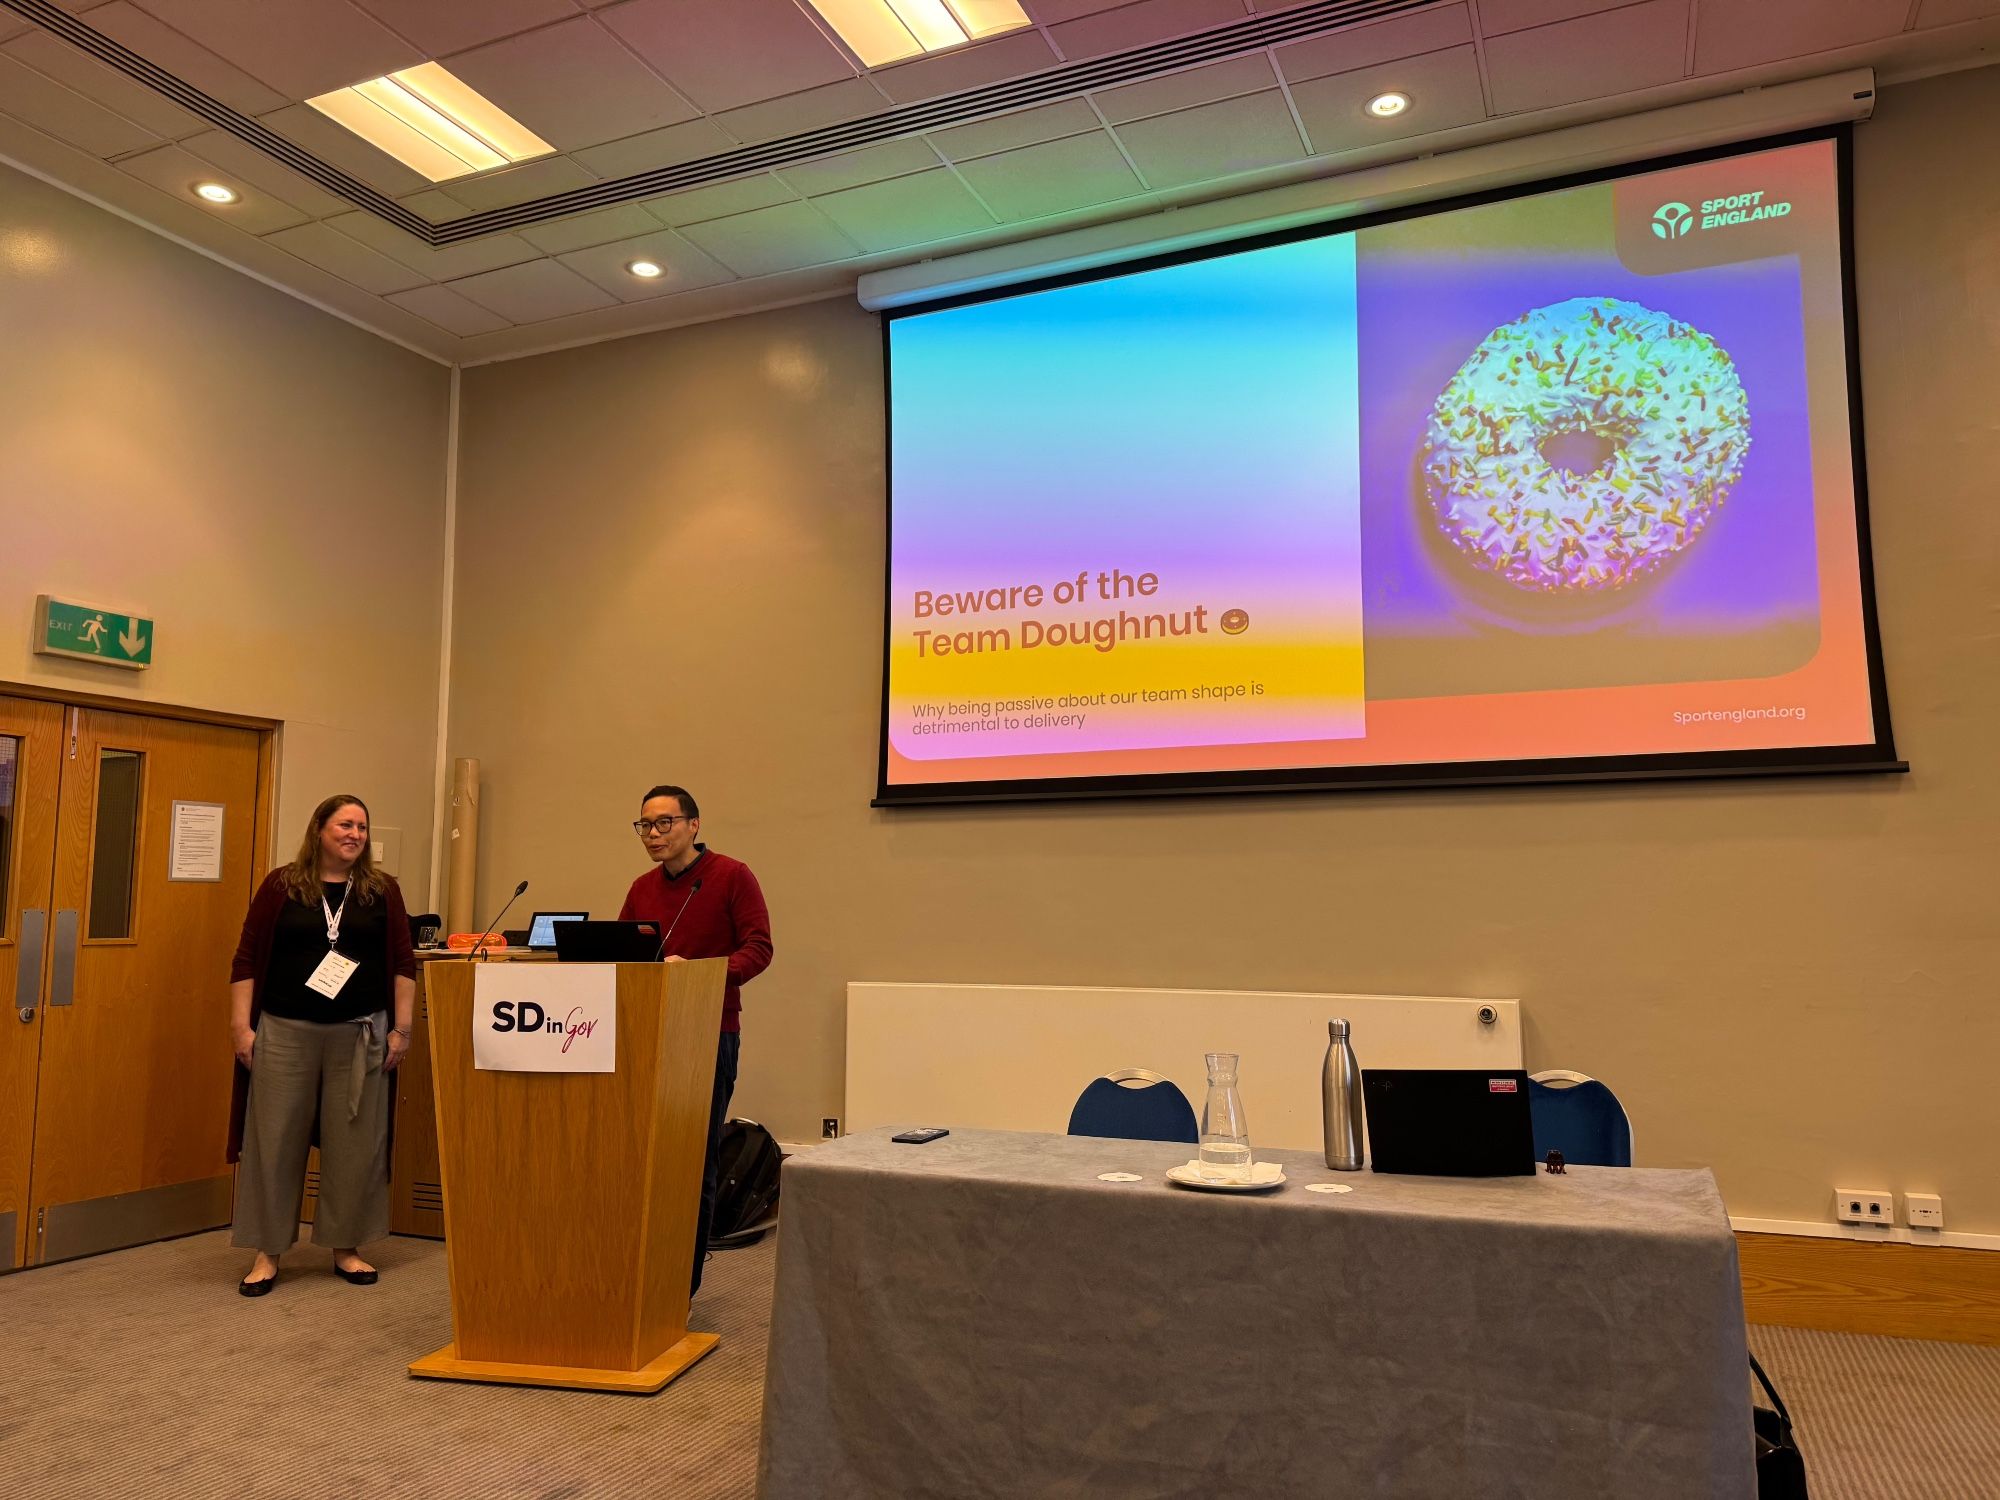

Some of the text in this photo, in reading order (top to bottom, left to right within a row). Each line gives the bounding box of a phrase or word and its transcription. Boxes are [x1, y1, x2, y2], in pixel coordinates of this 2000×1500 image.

[1701, 191, 1764, 213] SPORT
[1701, 202, 1791, 229] ENGLAND
[914, 568, 1159, 618] Beware of the
[49, 619, 73, 632] EXIT
[913, 605, 1208, 658] Team Doughnut
[912, 680, 1264, 720] Why being passive about our team shape is
[912, 713, 1086, 735] detrimental to delivery
[1673, 706, 1806, 724] Sportengland.org
